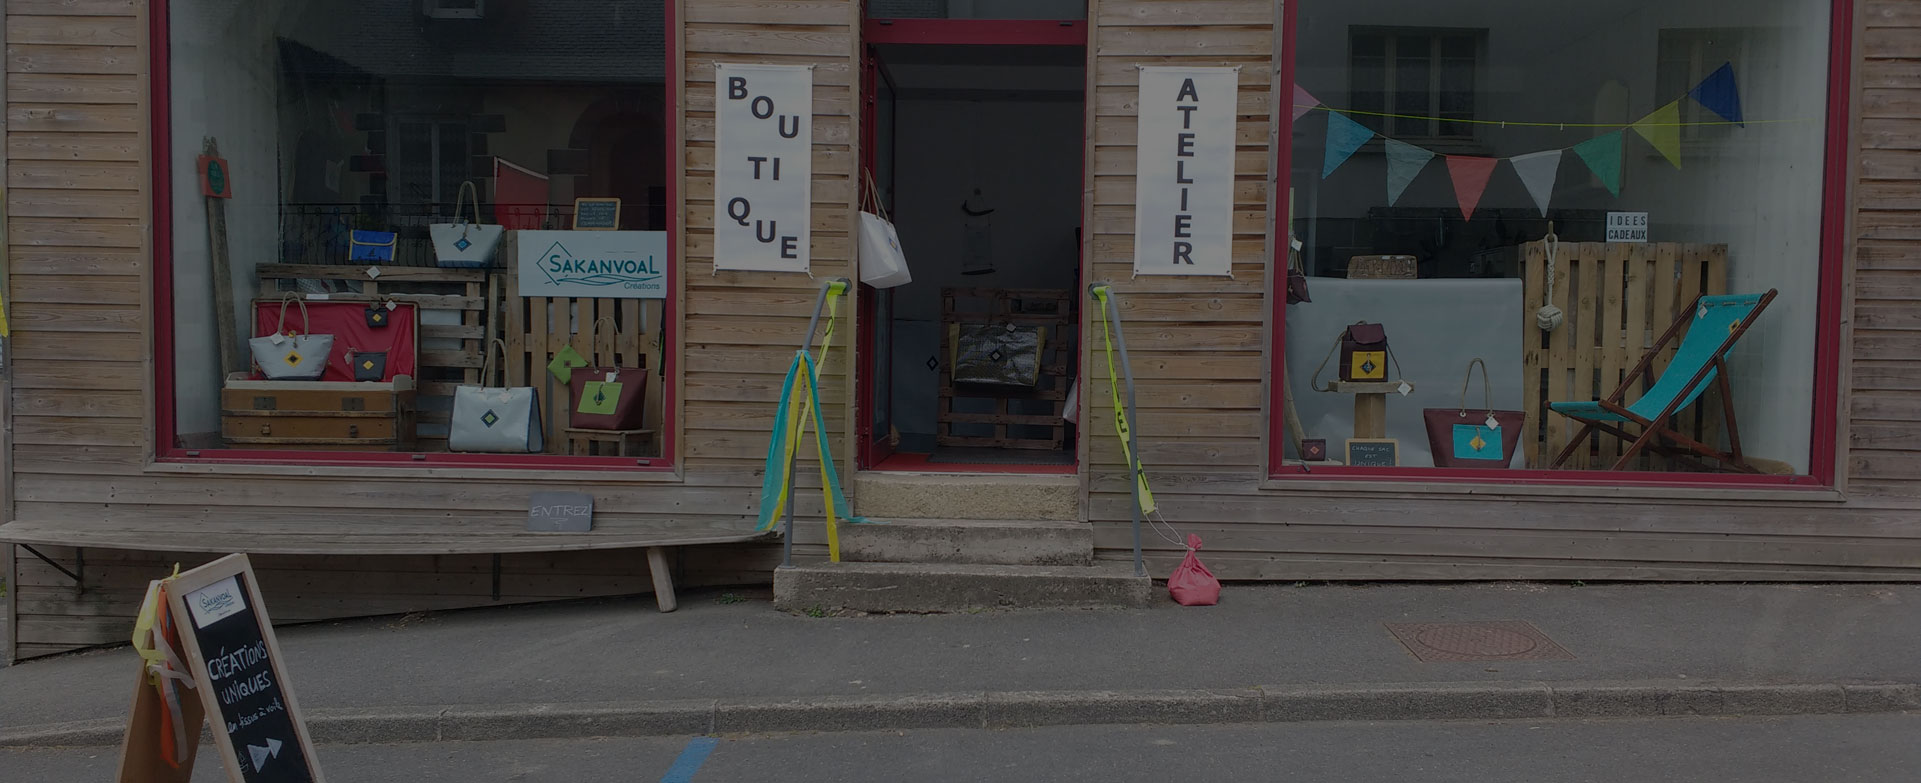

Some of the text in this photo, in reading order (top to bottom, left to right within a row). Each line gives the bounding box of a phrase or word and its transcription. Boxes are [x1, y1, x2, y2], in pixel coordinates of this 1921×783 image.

[1172, 78, 1199, 265] ATELIER
[1609, 215, 1646, 226] IDEES
[1608, 229, 1647, 240] CADEAUX
[549, 254, 660, 275] SAKANVOAL
[623, 281, 661, 290] Créations
[208, 639, 269, 681] CRÉATIONS
[221, 669, 271, 705] UNIQUES
